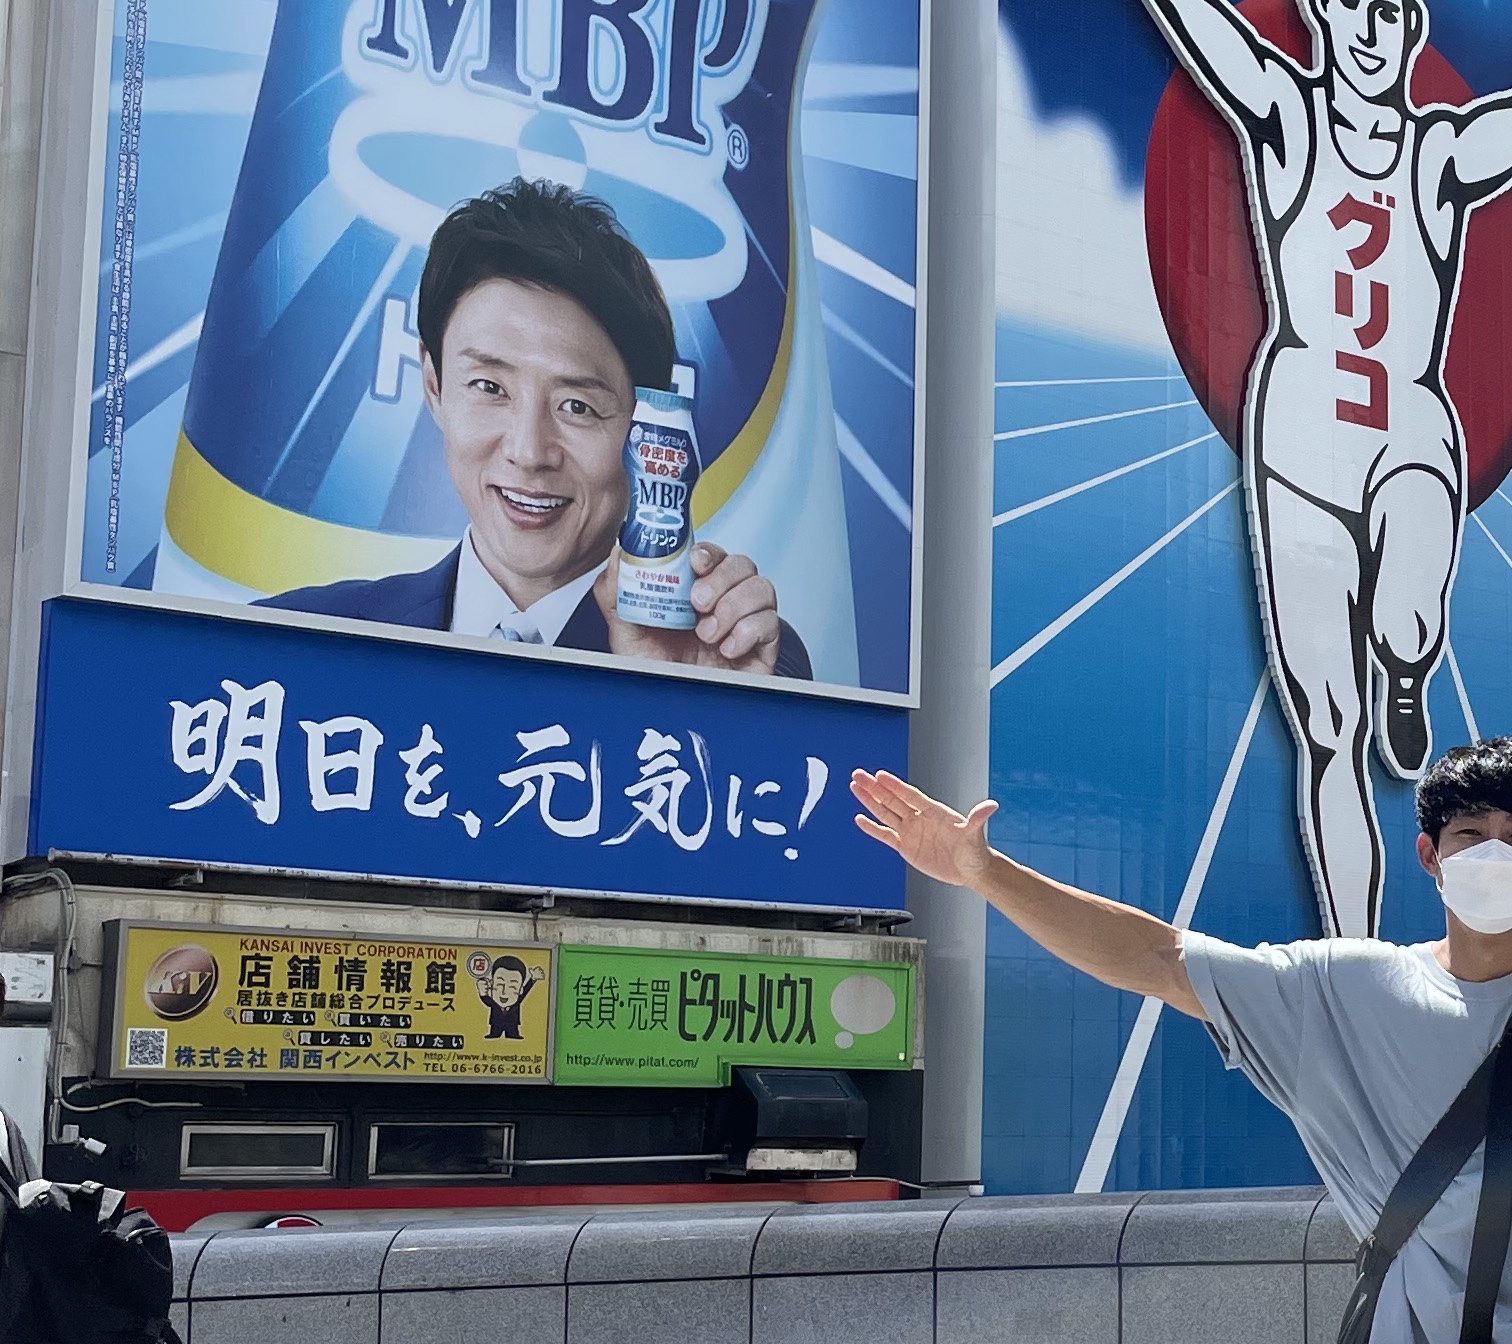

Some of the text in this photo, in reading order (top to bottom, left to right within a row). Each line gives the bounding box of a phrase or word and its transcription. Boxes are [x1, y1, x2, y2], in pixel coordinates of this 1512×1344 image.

[1326, 192, 1398, 431] グリコ
[640, 443, 687, 465] 骨密度を
[644, 460, 681, 479] 高める
[638, 478, 685, 511] MBP
[167, 678, 830, 862] 明日を、元気に!
[239, 937, 458, 962] KANSAI INVEST CORPORATION
[238, 952, 457, 996] 店舗情報館
[236, 990, 456, 1013] 居抜き店舗総合プロデュース
[573, 974, 671, 1031] 賃貸・売買
[678, 968, 817, 1046] ピタットハウス
[242, 1009, 315, 1024] 借りたい
[395, 1034, 463, 1050] 売りたい
[174, 1045, 416, 1071] 株式会社 関西インベスト
[424, 1063, 542, 1075] TEL 06-6766-2016
